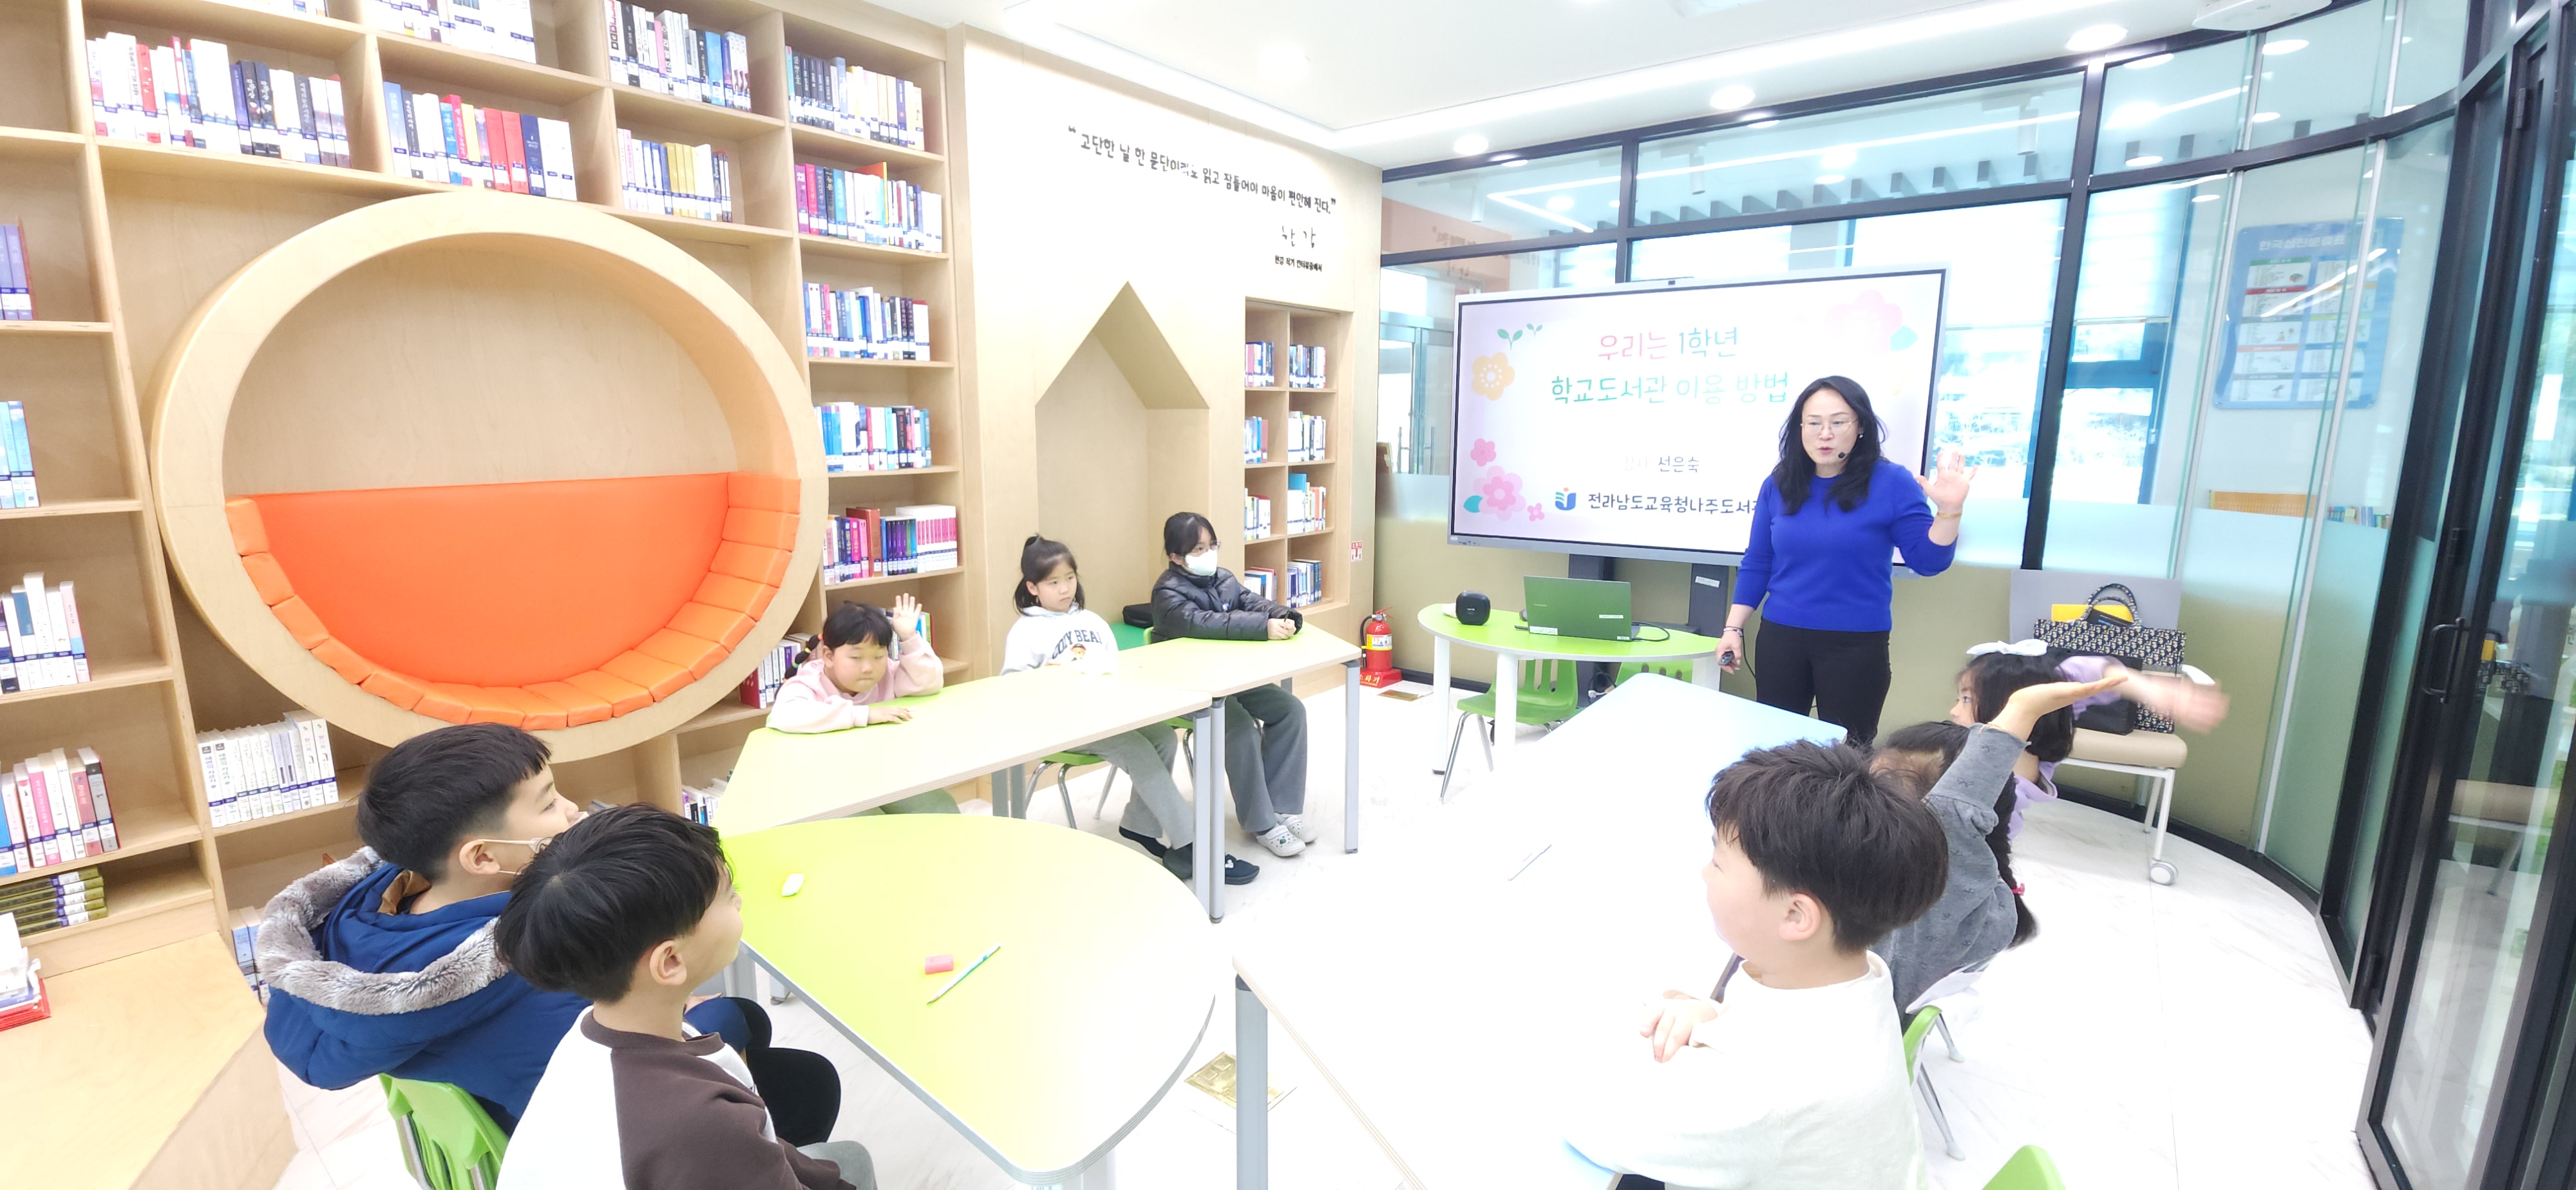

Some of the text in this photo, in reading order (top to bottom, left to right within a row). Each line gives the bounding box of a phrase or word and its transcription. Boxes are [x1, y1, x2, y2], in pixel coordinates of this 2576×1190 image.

[1119, 143, 1130, 163] 날
[1135, 147, 1145, 167] 한
[1202, 167, 1220, 185] 읽고
[1224, 172, 1258, 195] 잠들어야
[1261, 185, 1286, 202] 마음이
[1598, 326, 1738, 361] 우리는 1학년
[1551, 372, 1789, 404] 학교도서관 이용 방법
[1658, 455, 1700, 473] 선은숙
[1074, 629, 1103, 645] BEA
